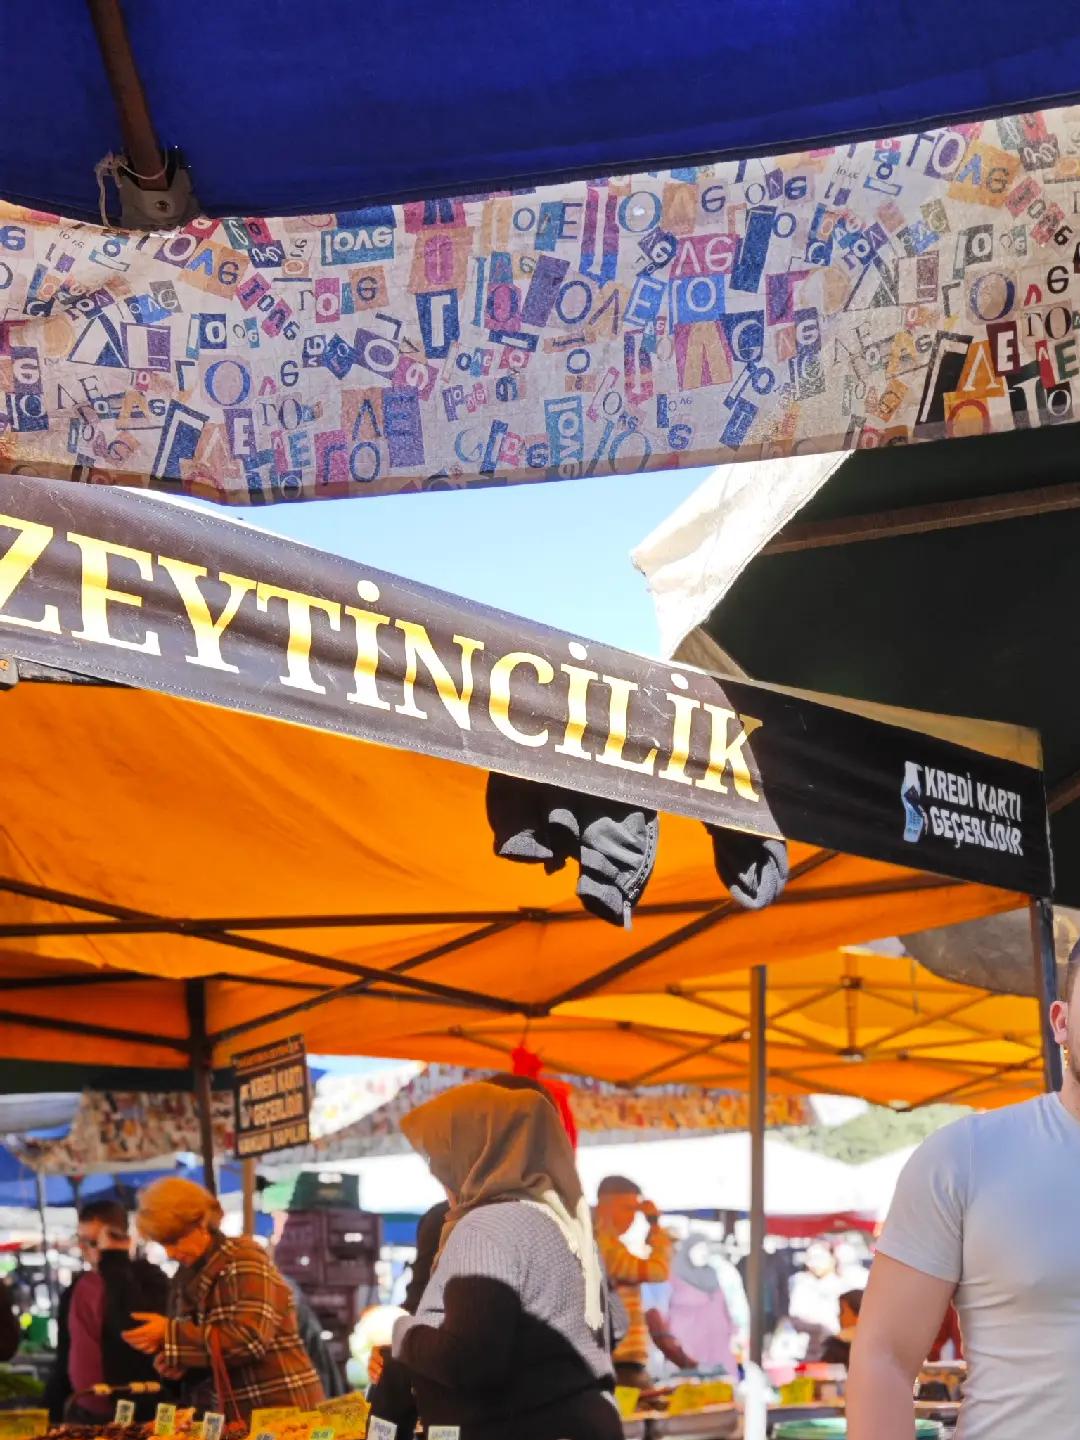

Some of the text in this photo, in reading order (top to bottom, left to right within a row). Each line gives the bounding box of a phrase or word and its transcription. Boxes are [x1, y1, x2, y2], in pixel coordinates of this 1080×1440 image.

[924, 766, 1022, 822] KREDİ KARTI
[929, 805, 1025, 857] GEÇERLİDİR
